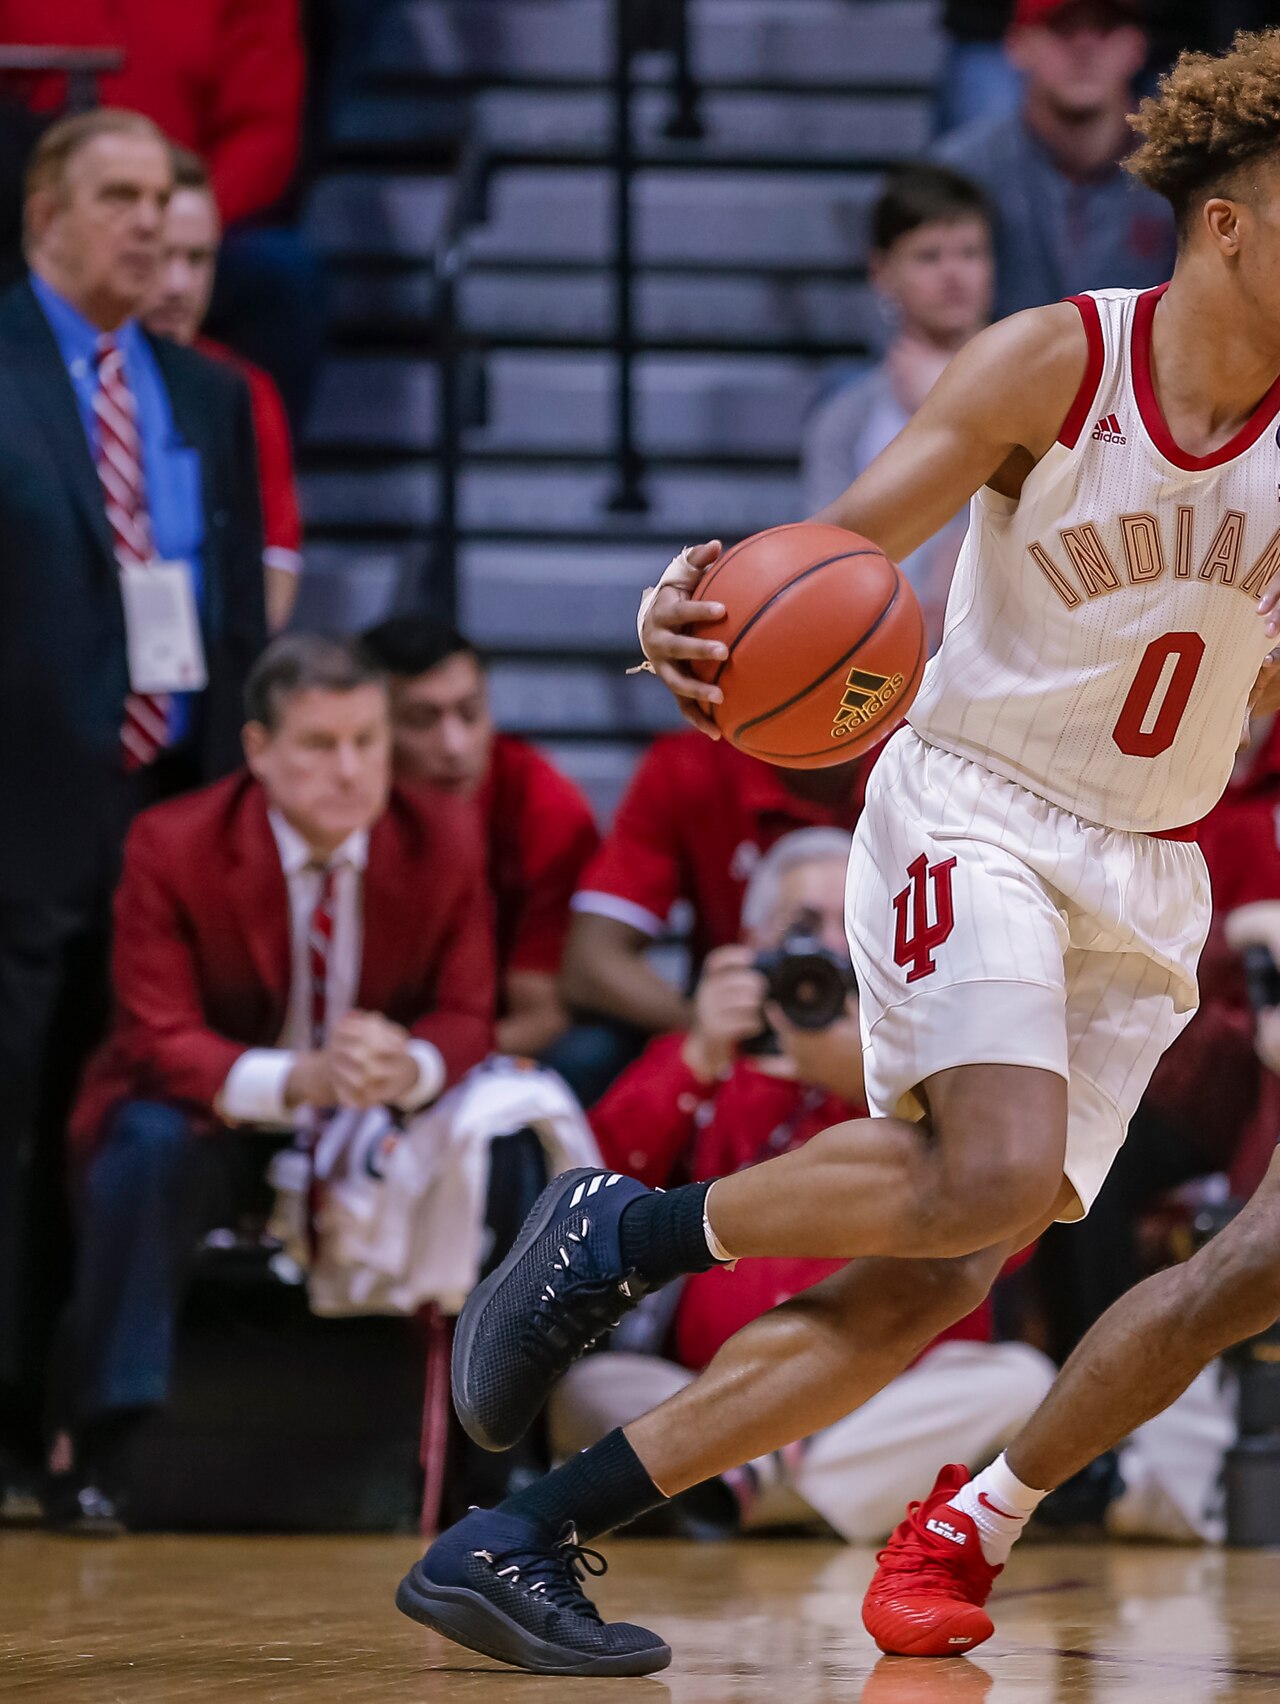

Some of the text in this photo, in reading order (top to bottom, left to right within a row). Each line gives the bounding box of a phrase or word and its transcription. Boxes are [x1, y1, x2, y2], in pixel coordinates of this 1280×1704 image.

[1091, 429, 1127, 446] didas
[830, 672, 905, 738] adidas
[1112, 631, 1206, 759] 0
